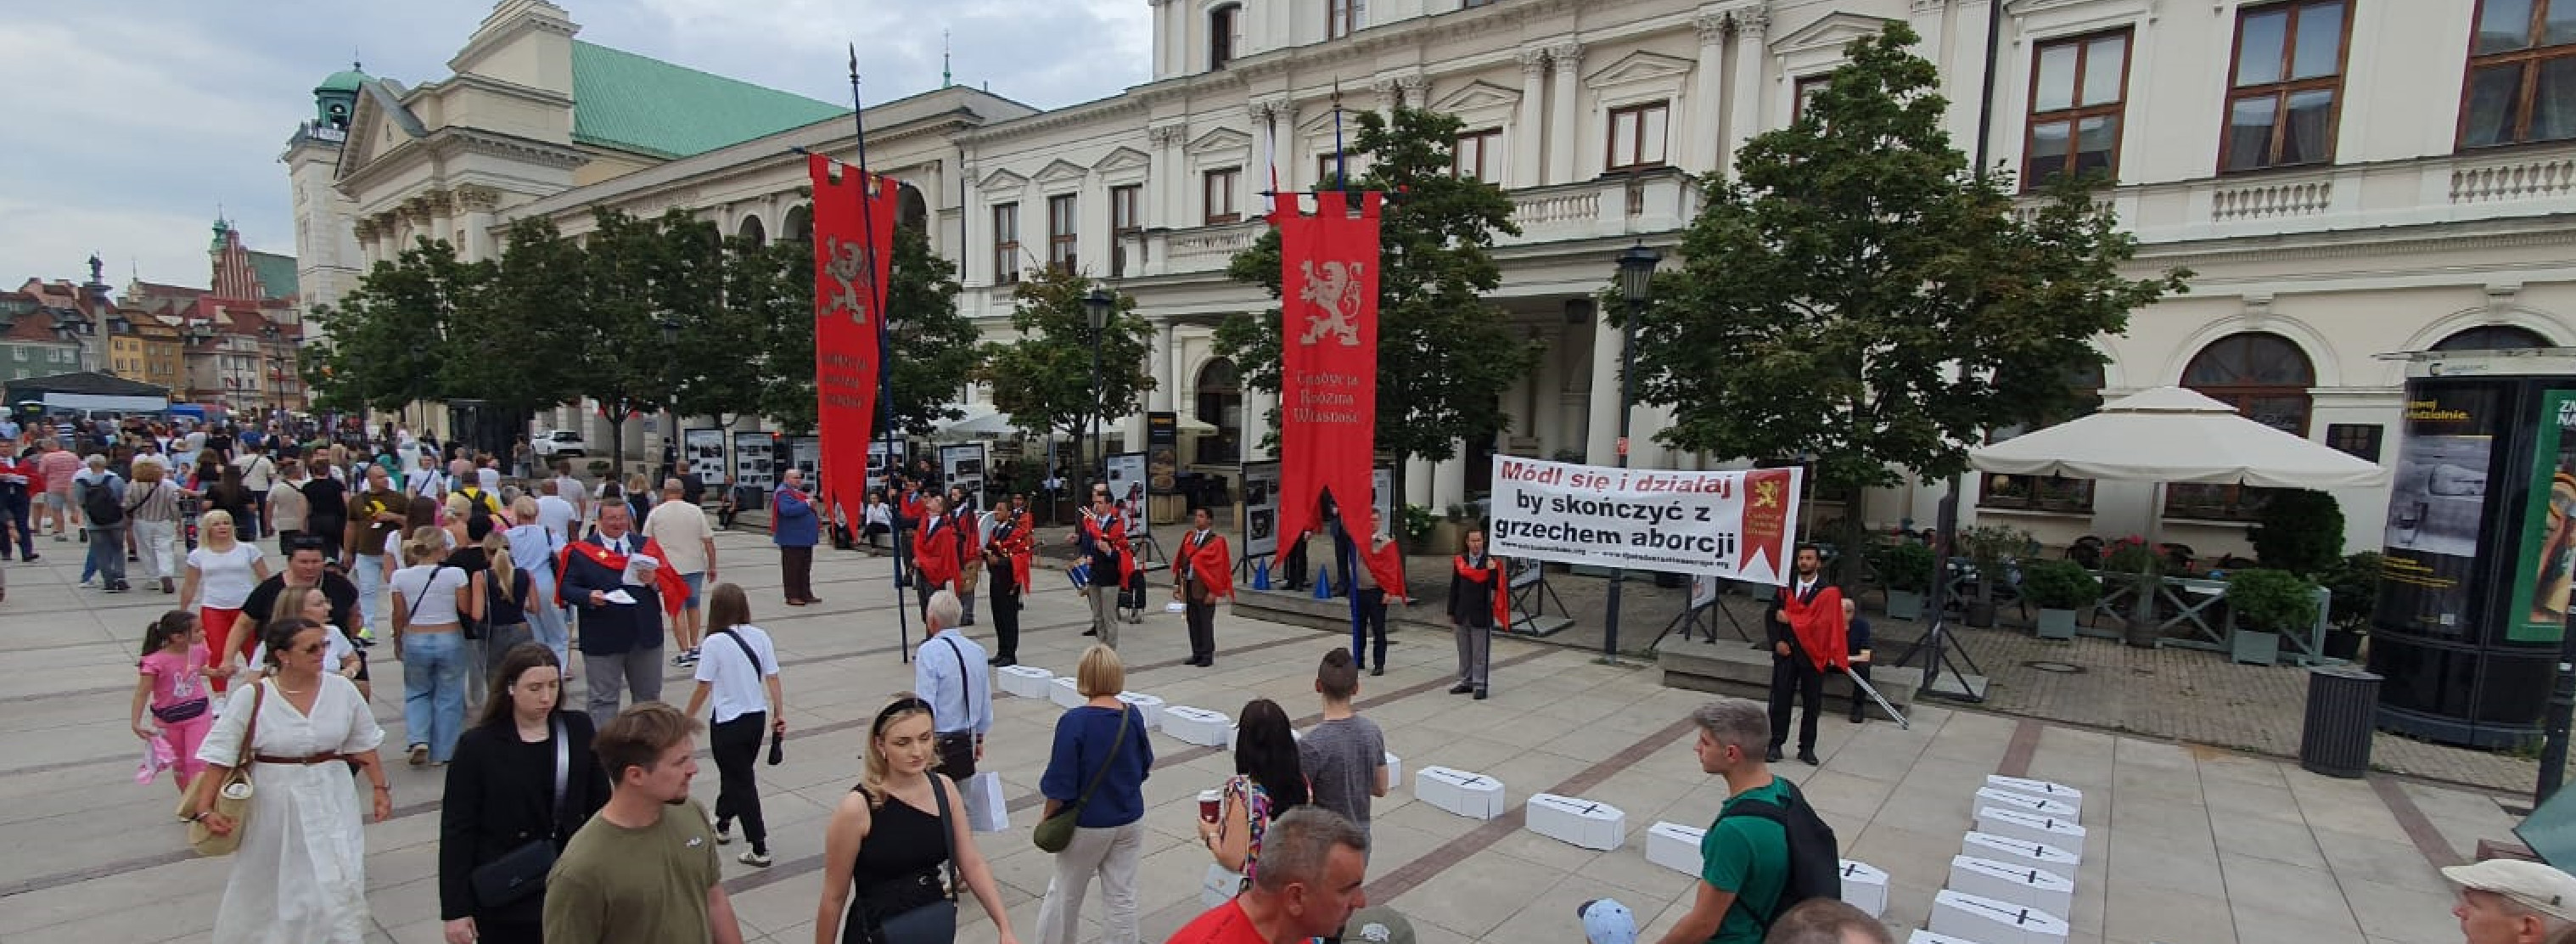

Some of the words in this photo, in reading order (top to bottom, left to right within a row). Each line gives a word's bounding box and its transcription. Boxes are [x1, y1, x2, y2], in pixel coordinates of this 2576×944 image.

[1501, 460, 1563, 486] Módl
[1570, 470, 1610, 493] się
[1618, 473, 1628, 492] i
[1635, 475, 1731, 500] działaj
[1516, 488, 1544, 515] by
[1552, 493, 1684, 525] skończyć
[1694, 506, 1711, 522] z
[1496, 519, 1622, 545] grzechem
[1631, 527, 1734, 559] aborcji
